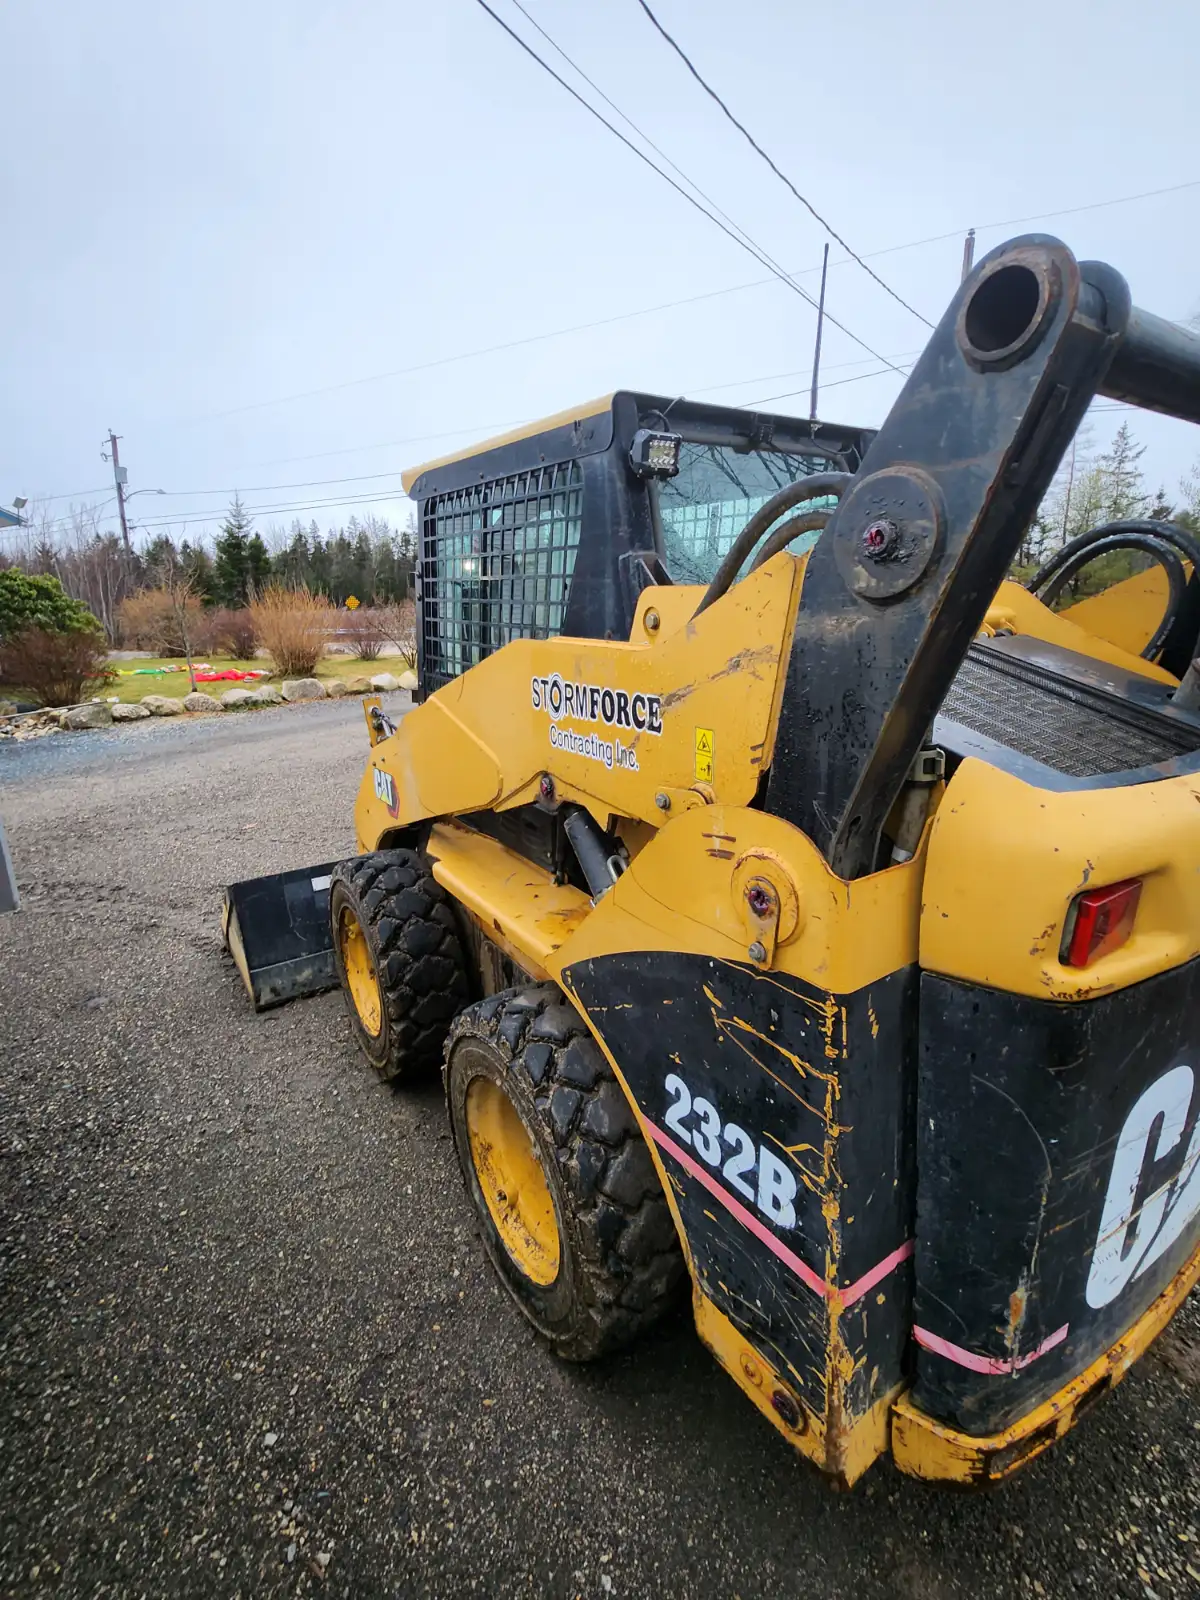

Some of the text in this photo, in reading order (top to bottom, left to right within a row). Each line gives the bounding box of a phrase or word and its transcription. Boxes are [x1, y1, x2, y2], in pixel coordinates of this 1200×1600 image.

[531, 674, 663, 734] STORMFORCE
[551, 725, 639, 770] Contracting Inc.
[664, 1073, 797, 1229] 232B
